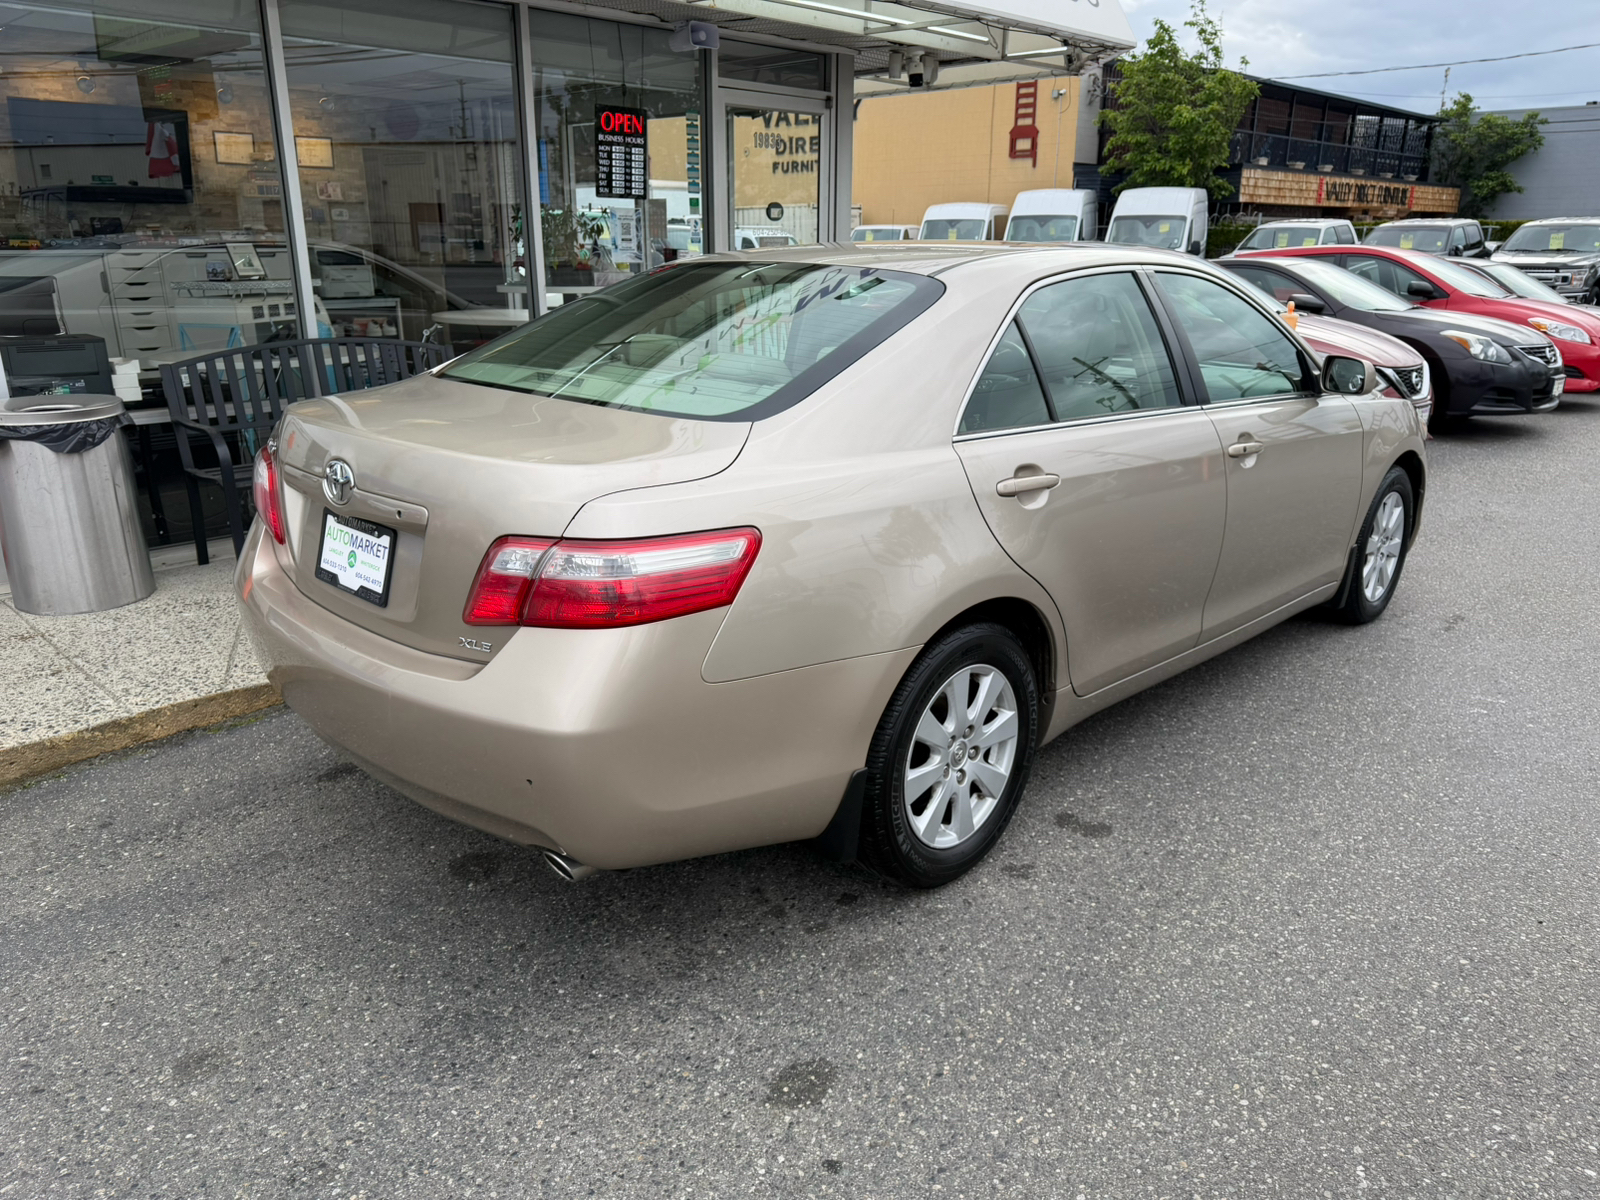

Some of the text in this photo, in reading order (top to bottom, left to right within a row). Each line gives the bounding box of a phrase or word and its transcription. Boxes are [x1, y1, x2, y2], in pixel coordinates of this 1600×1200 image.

[601, 111, 644, 134] OPEN
[598, 133, 644, 145] BUSINESS HOURS
[1325, 181, 1353, 202] VALLEY
[326, 525, 388, 560] AUTOMARKET
[458, 636, 492, 653] XLE
